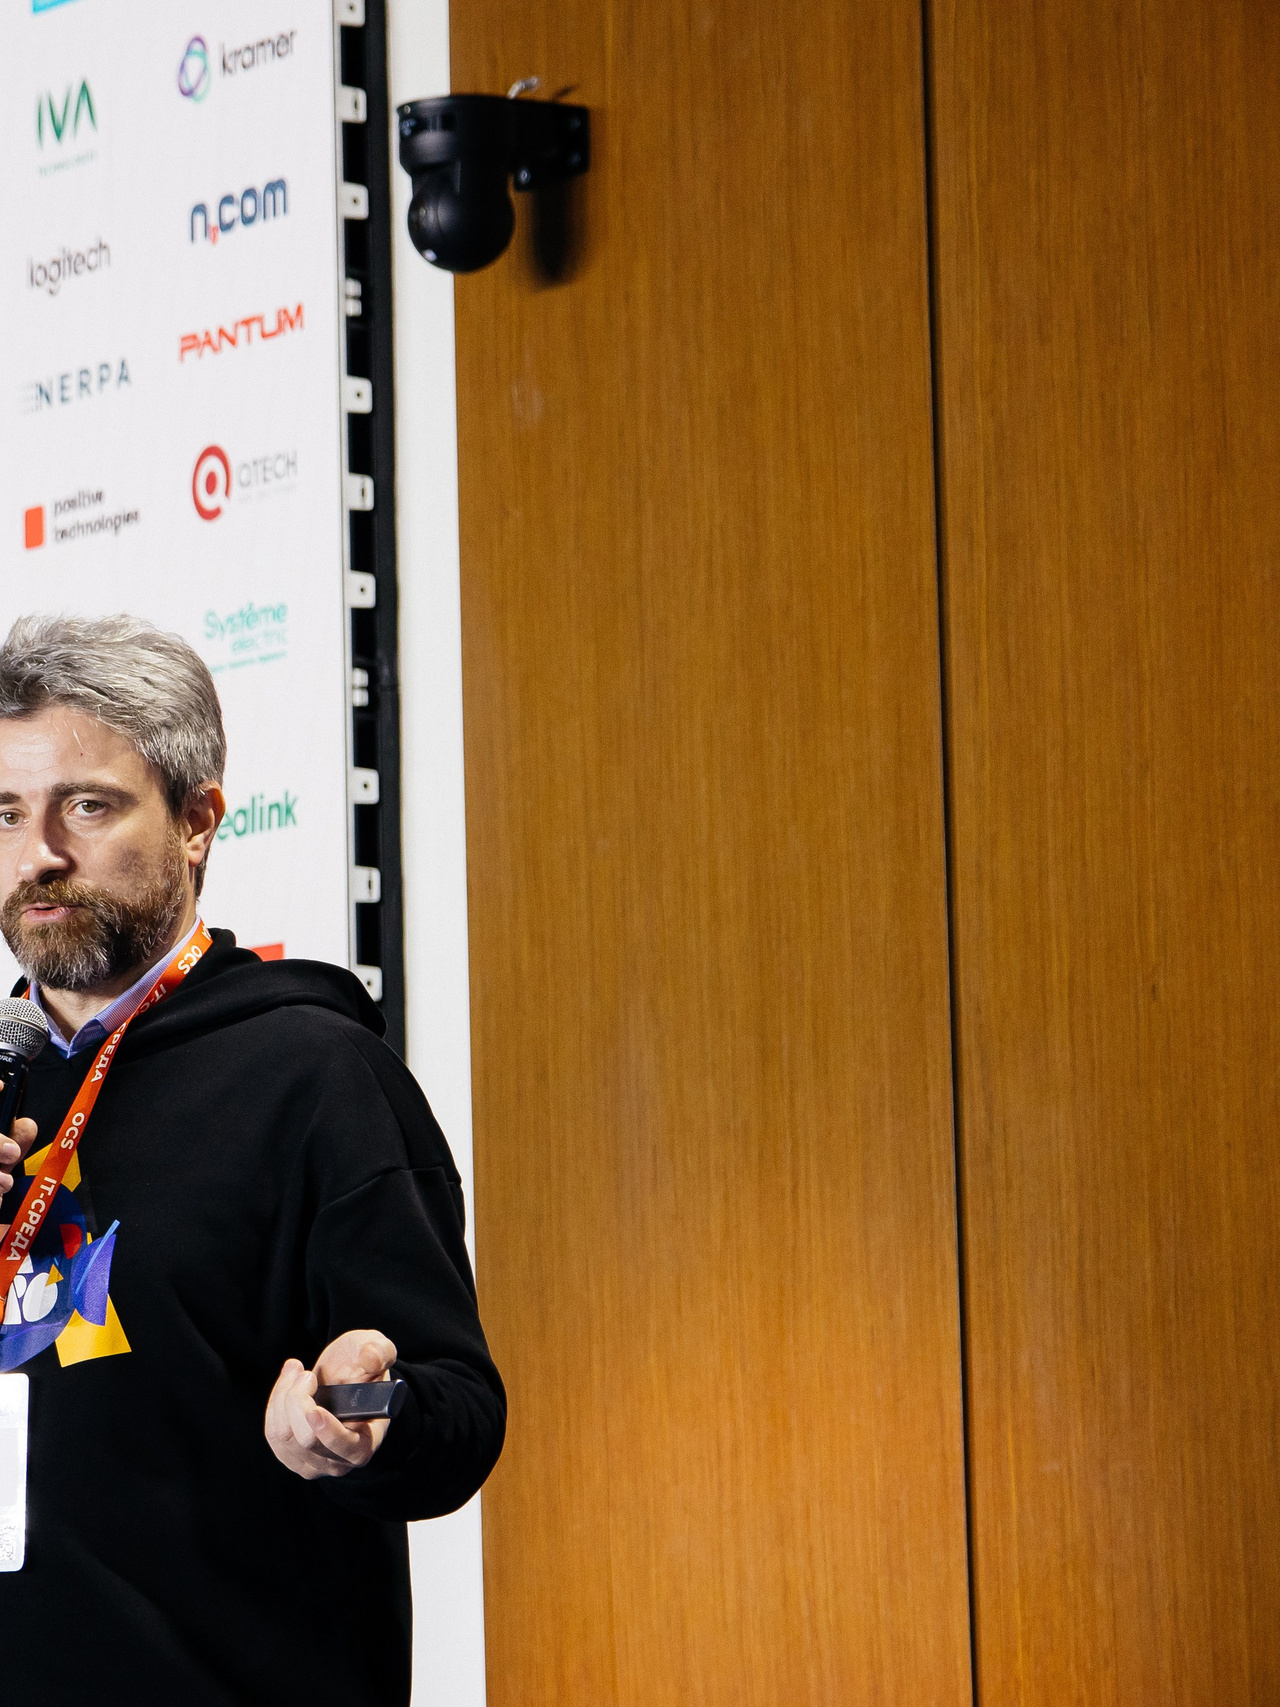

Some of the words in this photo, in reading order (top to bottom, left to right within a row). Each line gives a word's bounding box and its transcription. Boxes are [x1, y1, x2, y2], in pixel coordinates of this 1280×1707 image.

[220, 29, 298, 76] kramer
[37, 77, 98, 150] IVA
[27, 238, 111, 296] logitech
[179, 302, 304, 363] PANTUM
[35, 358, 131, 409] NERPA
[217, 790, 298, 841] ealink
[177, 944, 203, 975] OCS
[60, 1112, 85, 1150] OCS
[6, 1176, 57, 1261] IT-СРЕДА
